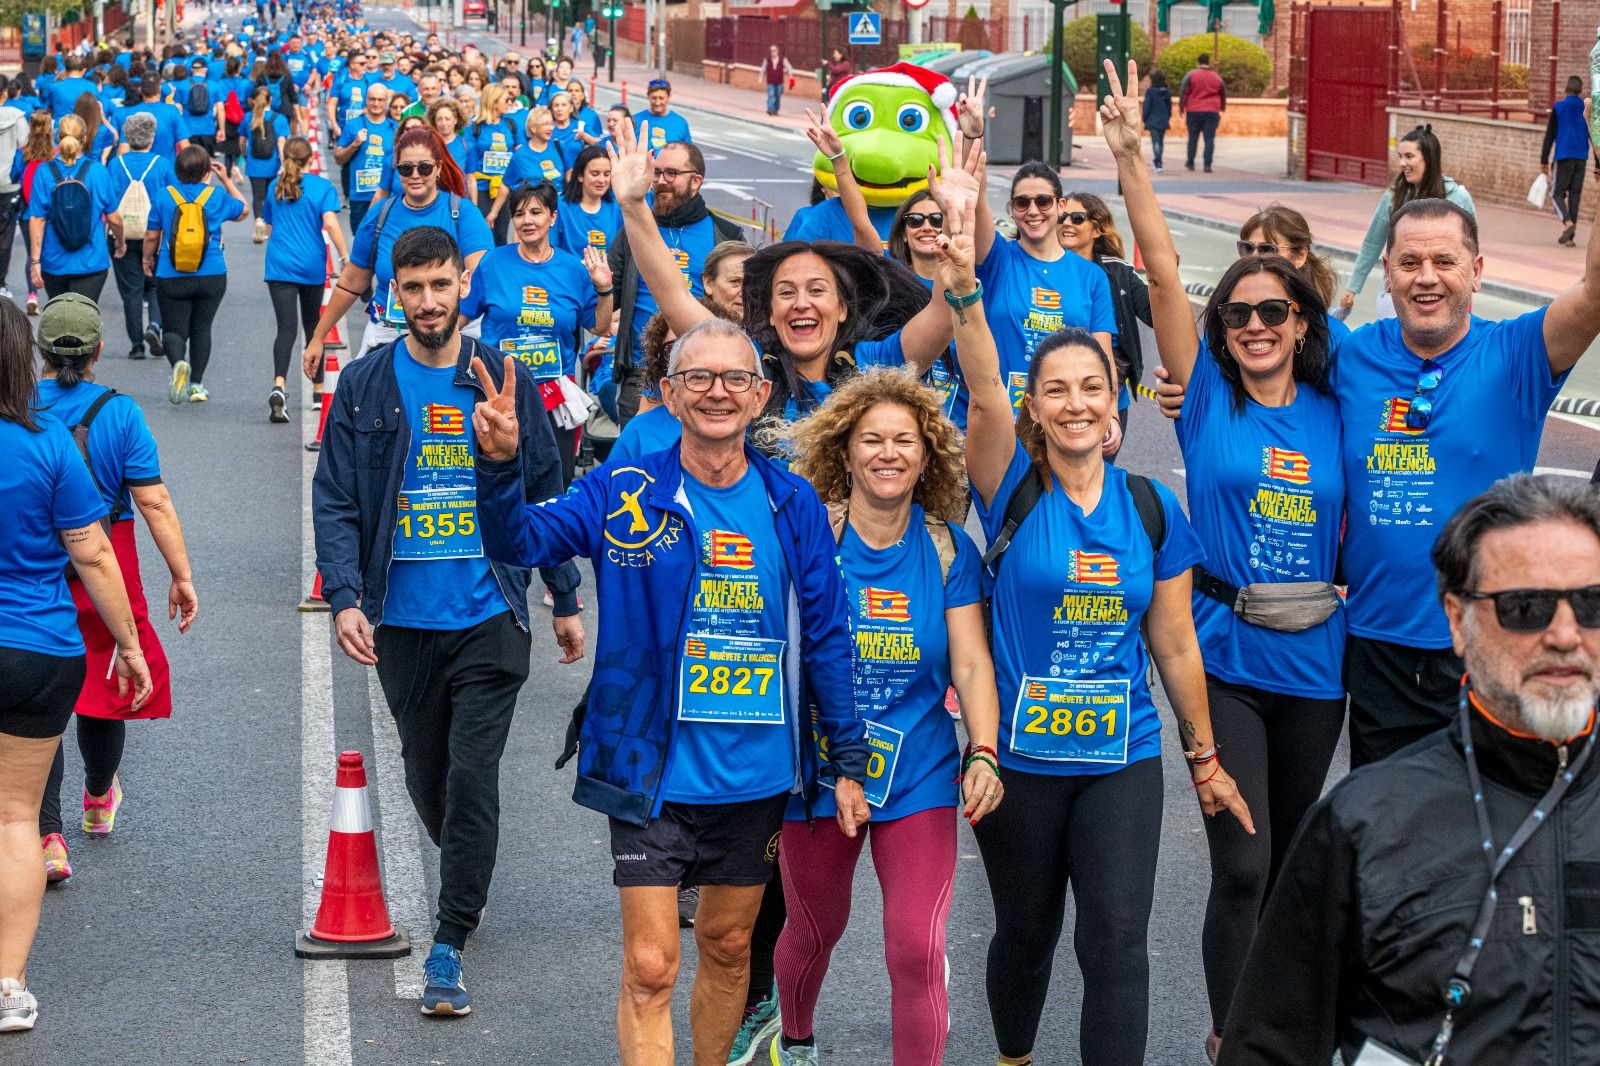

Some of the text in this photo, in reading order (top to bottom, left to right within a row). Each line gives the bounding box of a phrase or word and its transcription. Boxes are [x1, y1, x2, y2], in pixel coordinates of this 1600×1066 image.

[422, 444, 468, 456] MUÉVETE
[1374, 442, 1429, 458] MUÉVETE
[416, 456, 474, 467] X VALENCIA
[1367, 456, 1436, 470] X VALENCIA
[1257, 489, 1312, 510] MUÉVETE
[1249, 499, 1316, 523] X VALENCIA
[398, 512, 476, 538] 1355
[608, 548, 656, 568] CIEZA
[701, 578, 758, 596] MUÉVETE
[694, 593, 763, 609] X VALENCIA
[1063, 594, 1123, 609] MUÉVETE
[1053, 607, 1128, 622] X VALENCIA
[856, 630, 913, 647] MUÉVETE
[709, 650, 741, 662] MUÉVETE
[743, 654, 748, 662] X
[860, 645, 920, 660] VALENCIA
[689, 664, 774, 695] 2827
[1049, 693, 1124, 704] MUÉVETE X VALENCIA
[1024, 705, 1116, 736] 2861
[868, 737, 894, 752] LENCIA
